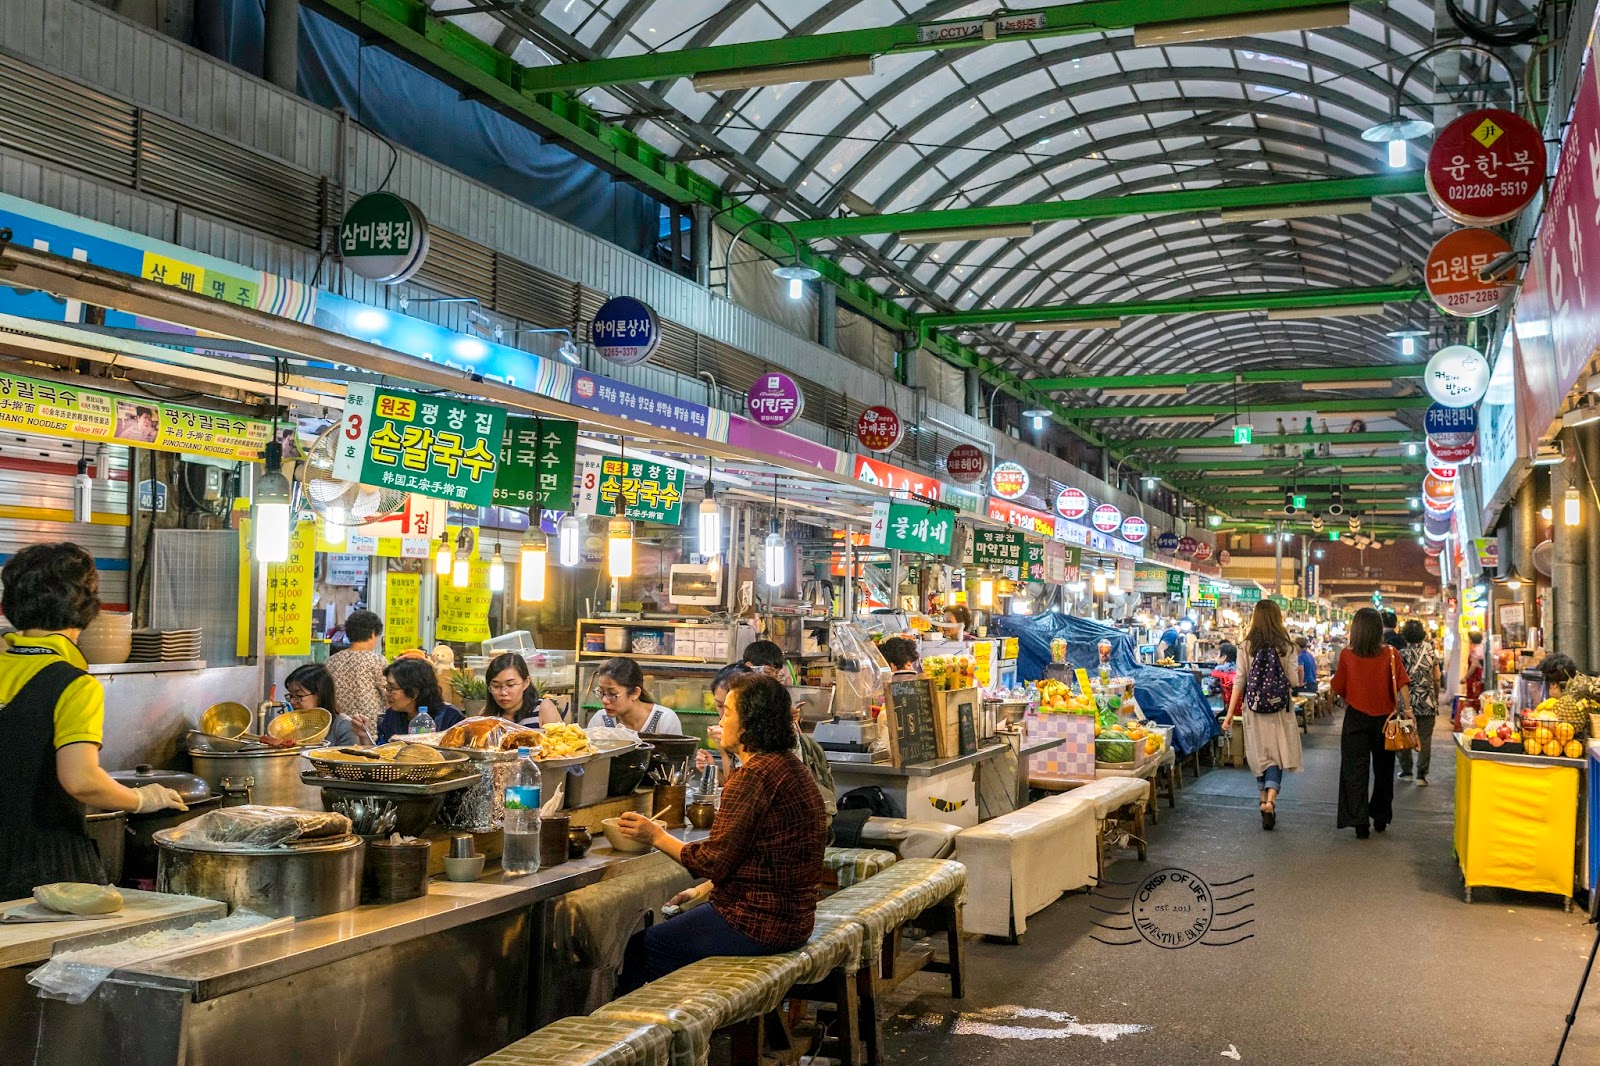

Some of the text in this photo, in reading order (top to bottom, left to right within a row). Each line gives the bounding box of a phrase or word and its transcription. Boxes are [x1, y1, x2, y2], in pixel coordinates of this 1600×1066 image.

[941, 26, 968, 38] CCTV
[1442, 150, 1534, 181] 윤한복
[1449, 181, 1528, 200] 02)2268-5519
[341, 221, 411, 250] 삼미횟집
[1448, 290, 1499, 306] 2267-2289
[594, 319, 650, 338] 하이론상사
[604, 347, 637, 357] 2265-3379
[380, 397, 411, 418] 원조
[598, 385, 617, 403] 목화솜
[619, 391, 636, 408] 명주솜
[638, 396, 654, 413] 양모솜
[656, 401, 672, 418] 화학솜
[751, 398, 794, 413] 아랑주
[27, 418, 68, 431] NOODLES
[74, 425, 108, 436] since 1977
[346, 414, 363, 440] 3
[162, 439, 233, 456] PINGCHANG NOODLES
[345, 446, 355, 459] 호
[370, 421, 497, 482] 손칼국수
[606, 462, 626, 474] 원조
[539, 473, 557, 491] 면
[584, 473, 595, 490] 3
[585, 493, 592, 501] 호
[600, 475, 681, 510] 손칼국수
[415, 510, 430, 534] 집
[875, 518, 883, 531] 4
[976, 542, 1020, 558] 마약김밥
